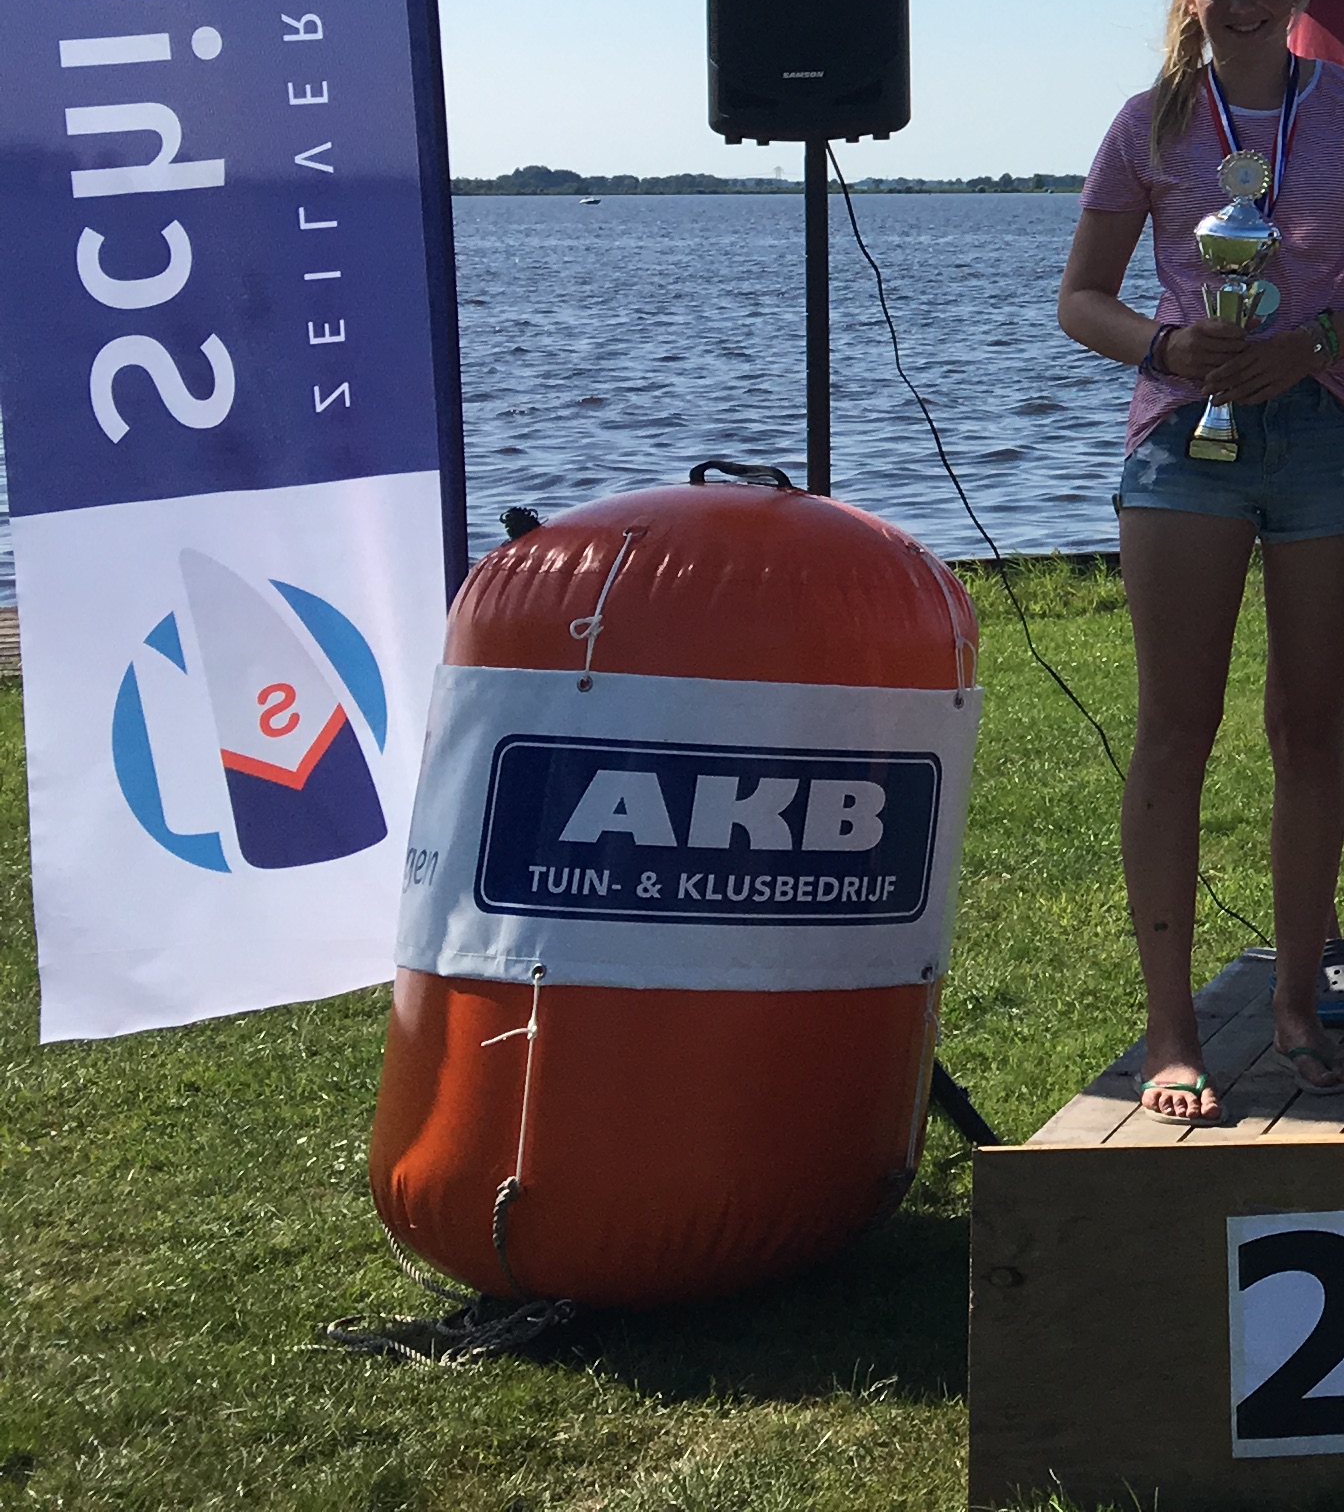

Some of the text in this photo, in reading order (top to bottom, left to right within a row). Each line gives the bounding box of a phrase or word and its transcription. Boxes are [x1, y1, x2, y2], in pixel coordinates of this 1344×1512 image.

[557, 769, 886, 852] AKB
[528, 865, 897, 903] TUIN- & KLUSBEDRIJF
